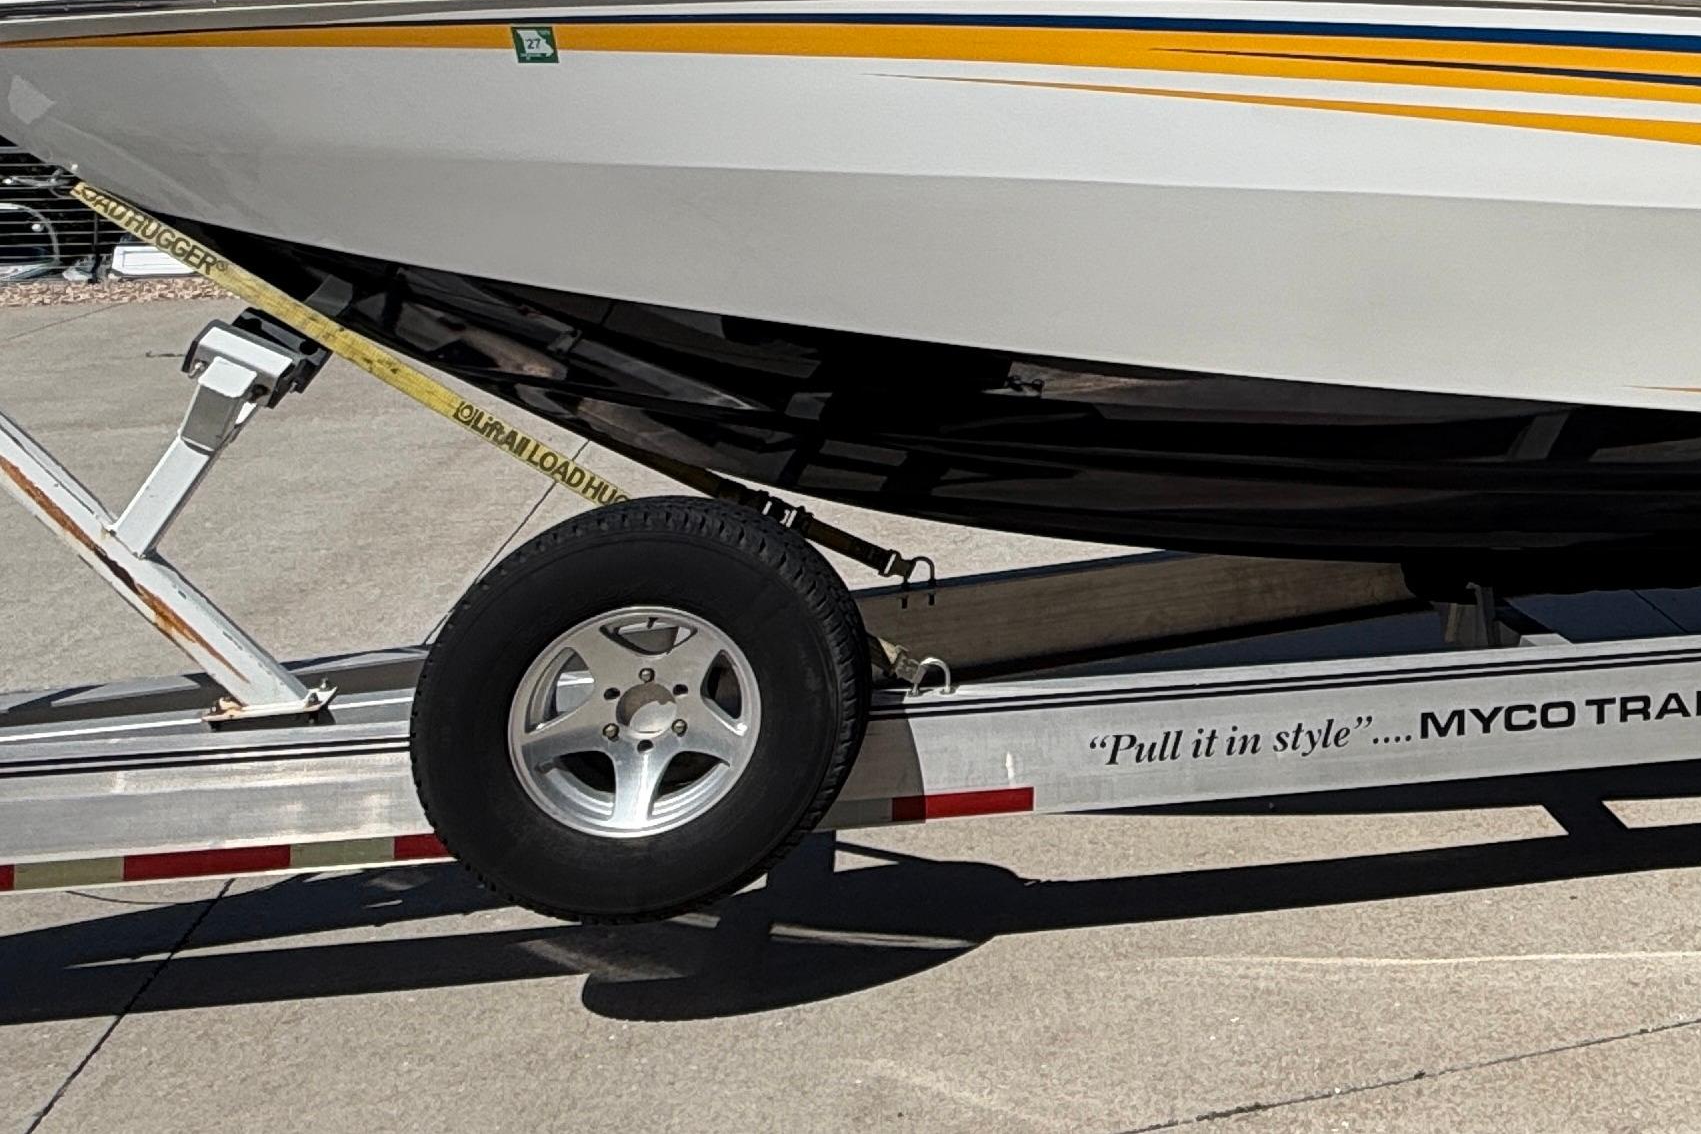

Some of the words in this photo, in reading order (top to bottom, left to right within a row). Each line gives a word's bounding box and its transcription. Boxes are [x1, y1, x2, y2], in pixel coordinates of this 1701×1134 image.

[527, 443, 586, 488] LOAD
[1191, 726, 1218, 759] it
[1225, 725, 1262, 756] in
[1420, 699, 1576, 740] MYCO
